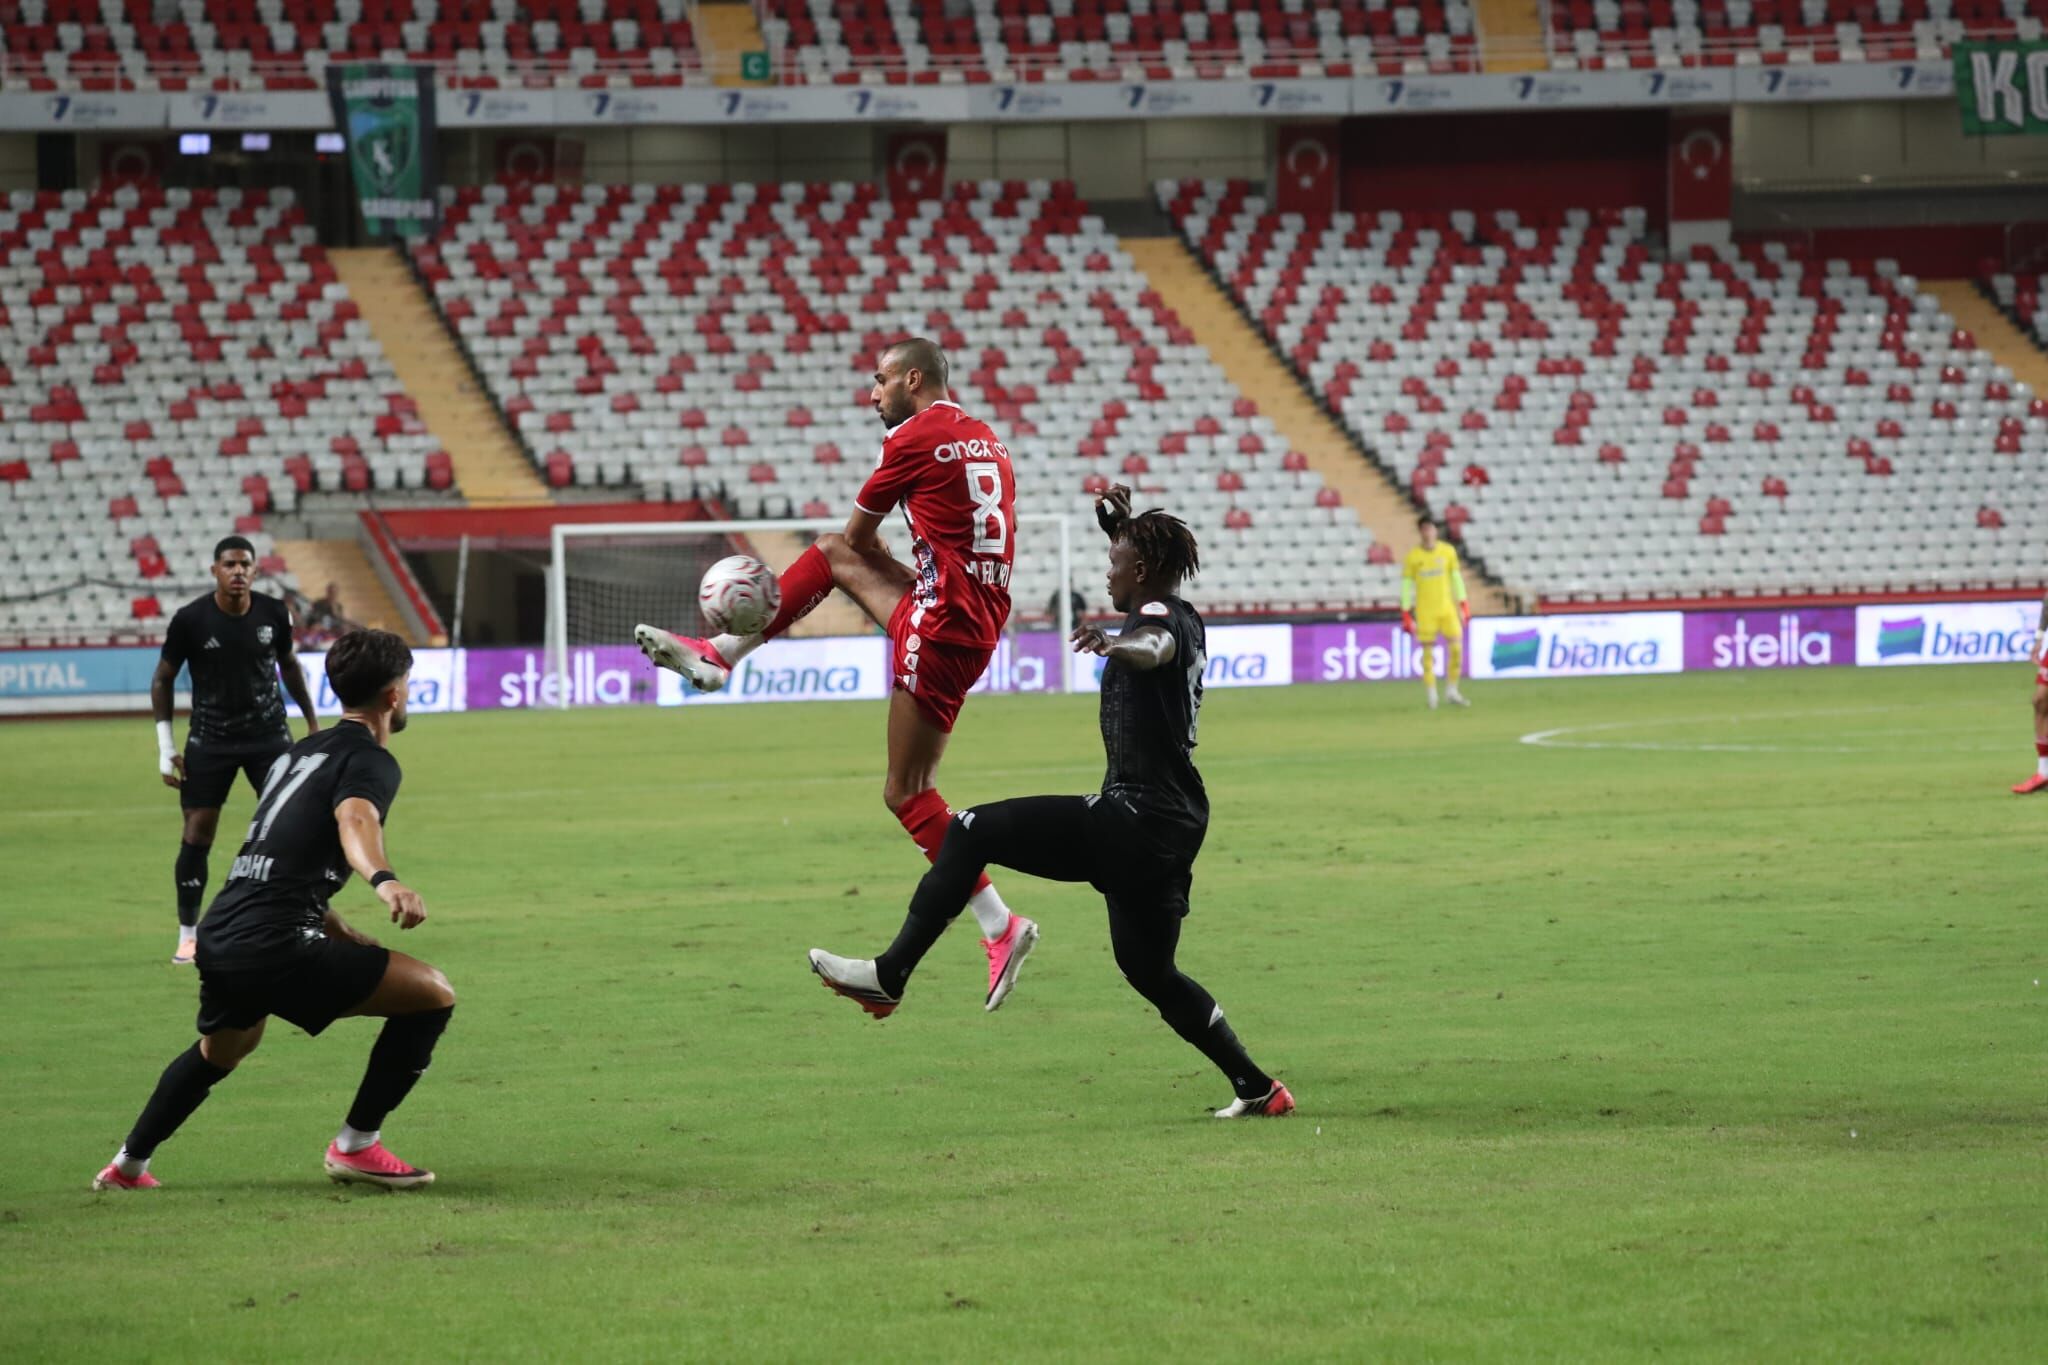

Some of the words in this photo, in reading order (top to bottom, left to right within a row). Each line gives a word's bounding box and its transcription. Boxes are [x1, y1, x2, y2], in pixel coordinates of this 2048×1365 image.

[965, 462, 1005, 553] 8
[1322, 627, 1444, 680] stella
[1547, 633, 1659, 669] bianca
[1713, 614, 1831, 668] stella
[1932, 620, 2039, 656] bianca
[0, 663, 86, 689] PITAL
[500, 651, 631, 707] stella
[741, 659, 861, 694] bianca
